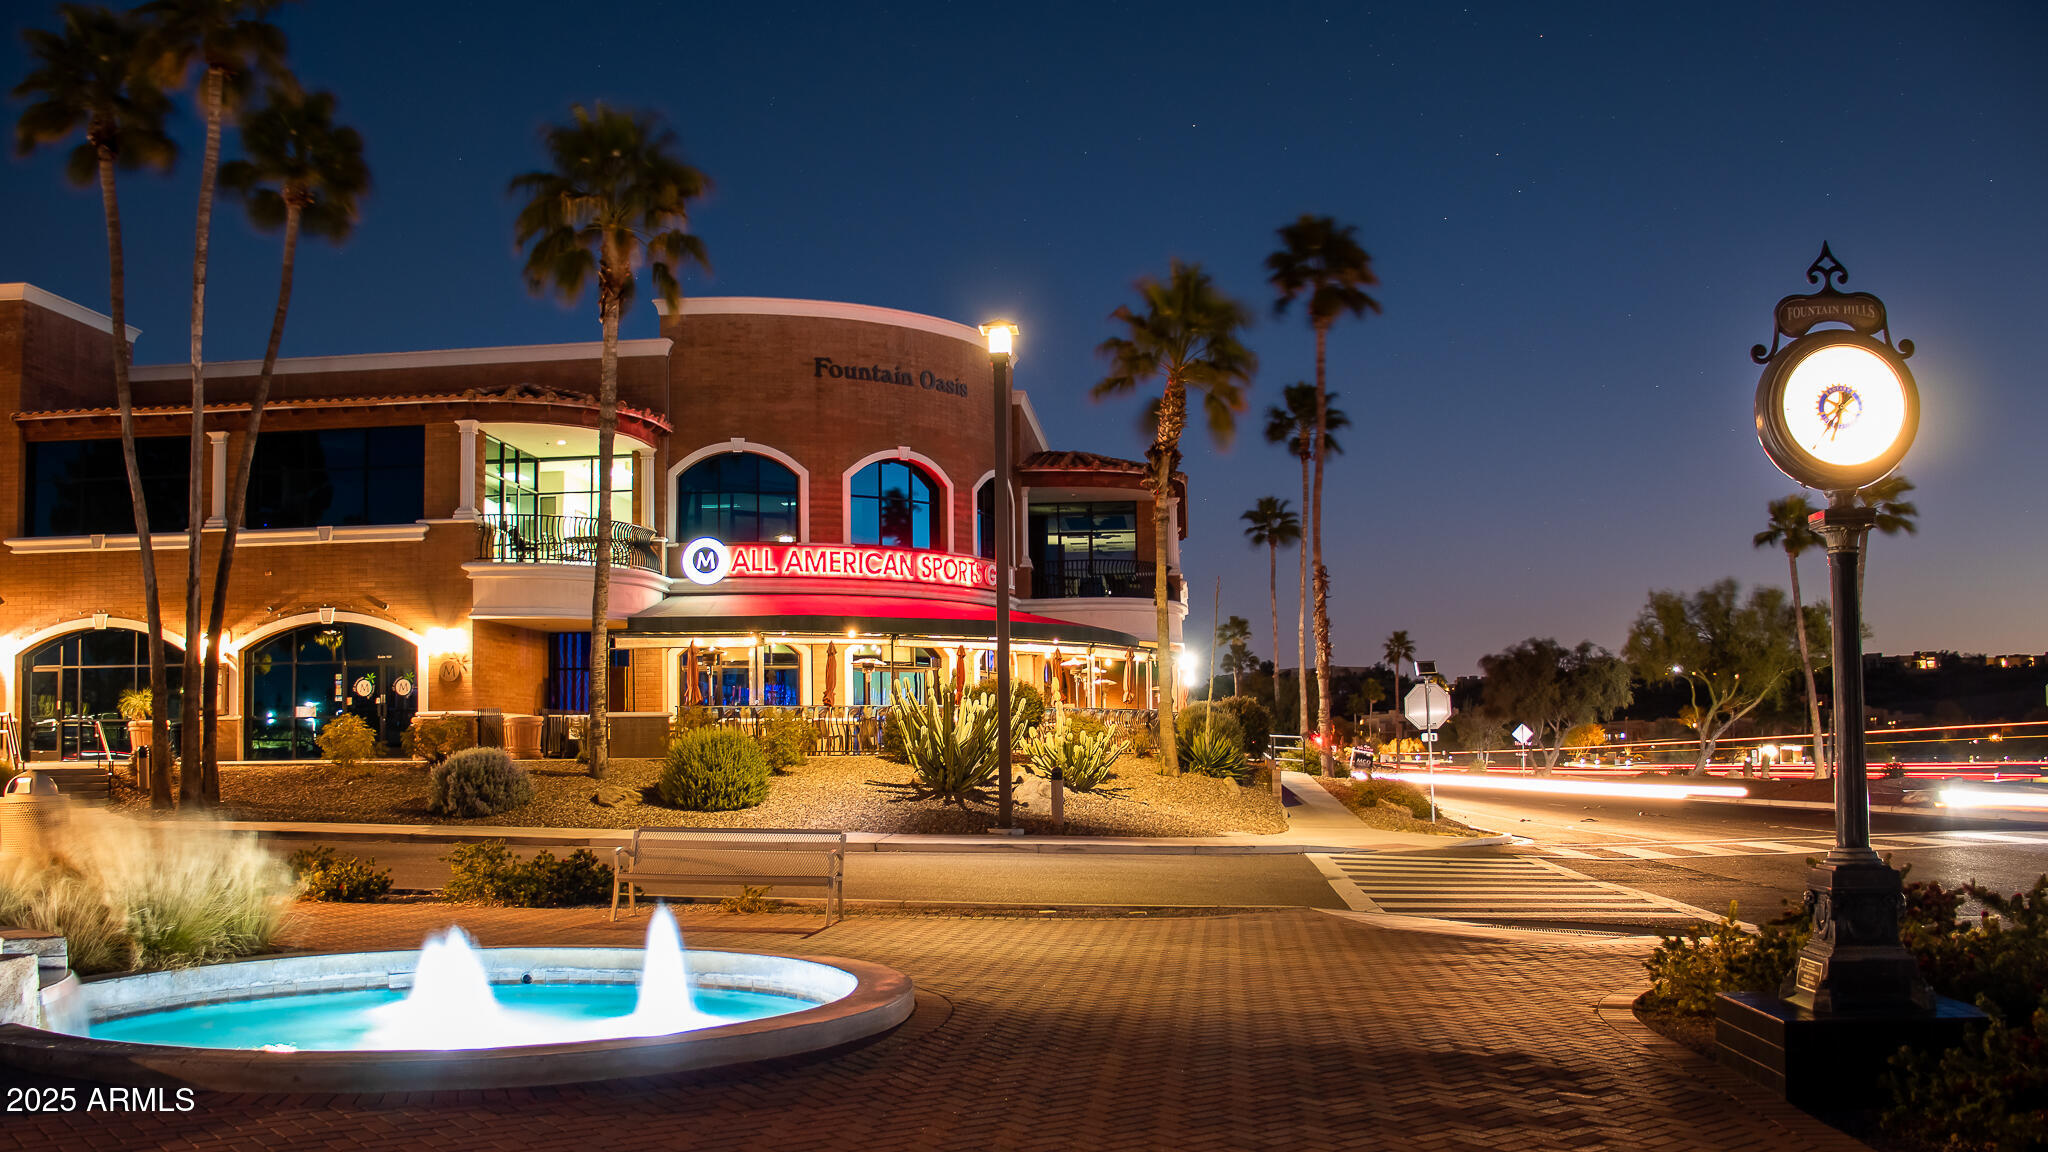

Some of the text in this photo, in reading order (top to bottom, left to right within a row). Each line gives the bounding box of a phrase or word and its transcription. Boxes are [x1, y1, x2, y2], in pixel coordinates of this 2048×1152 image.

[1788, 304, 1875, 320] FOUNTAIN HILLS
[814, 357, 968, 397] Fountain Oasis
[731, 549, 776, 572] ALL
[785, 550, 913, 577] AMERICAN
[921, 556, 983, 584] SPORTS
[443, 666, 455, 678] M
